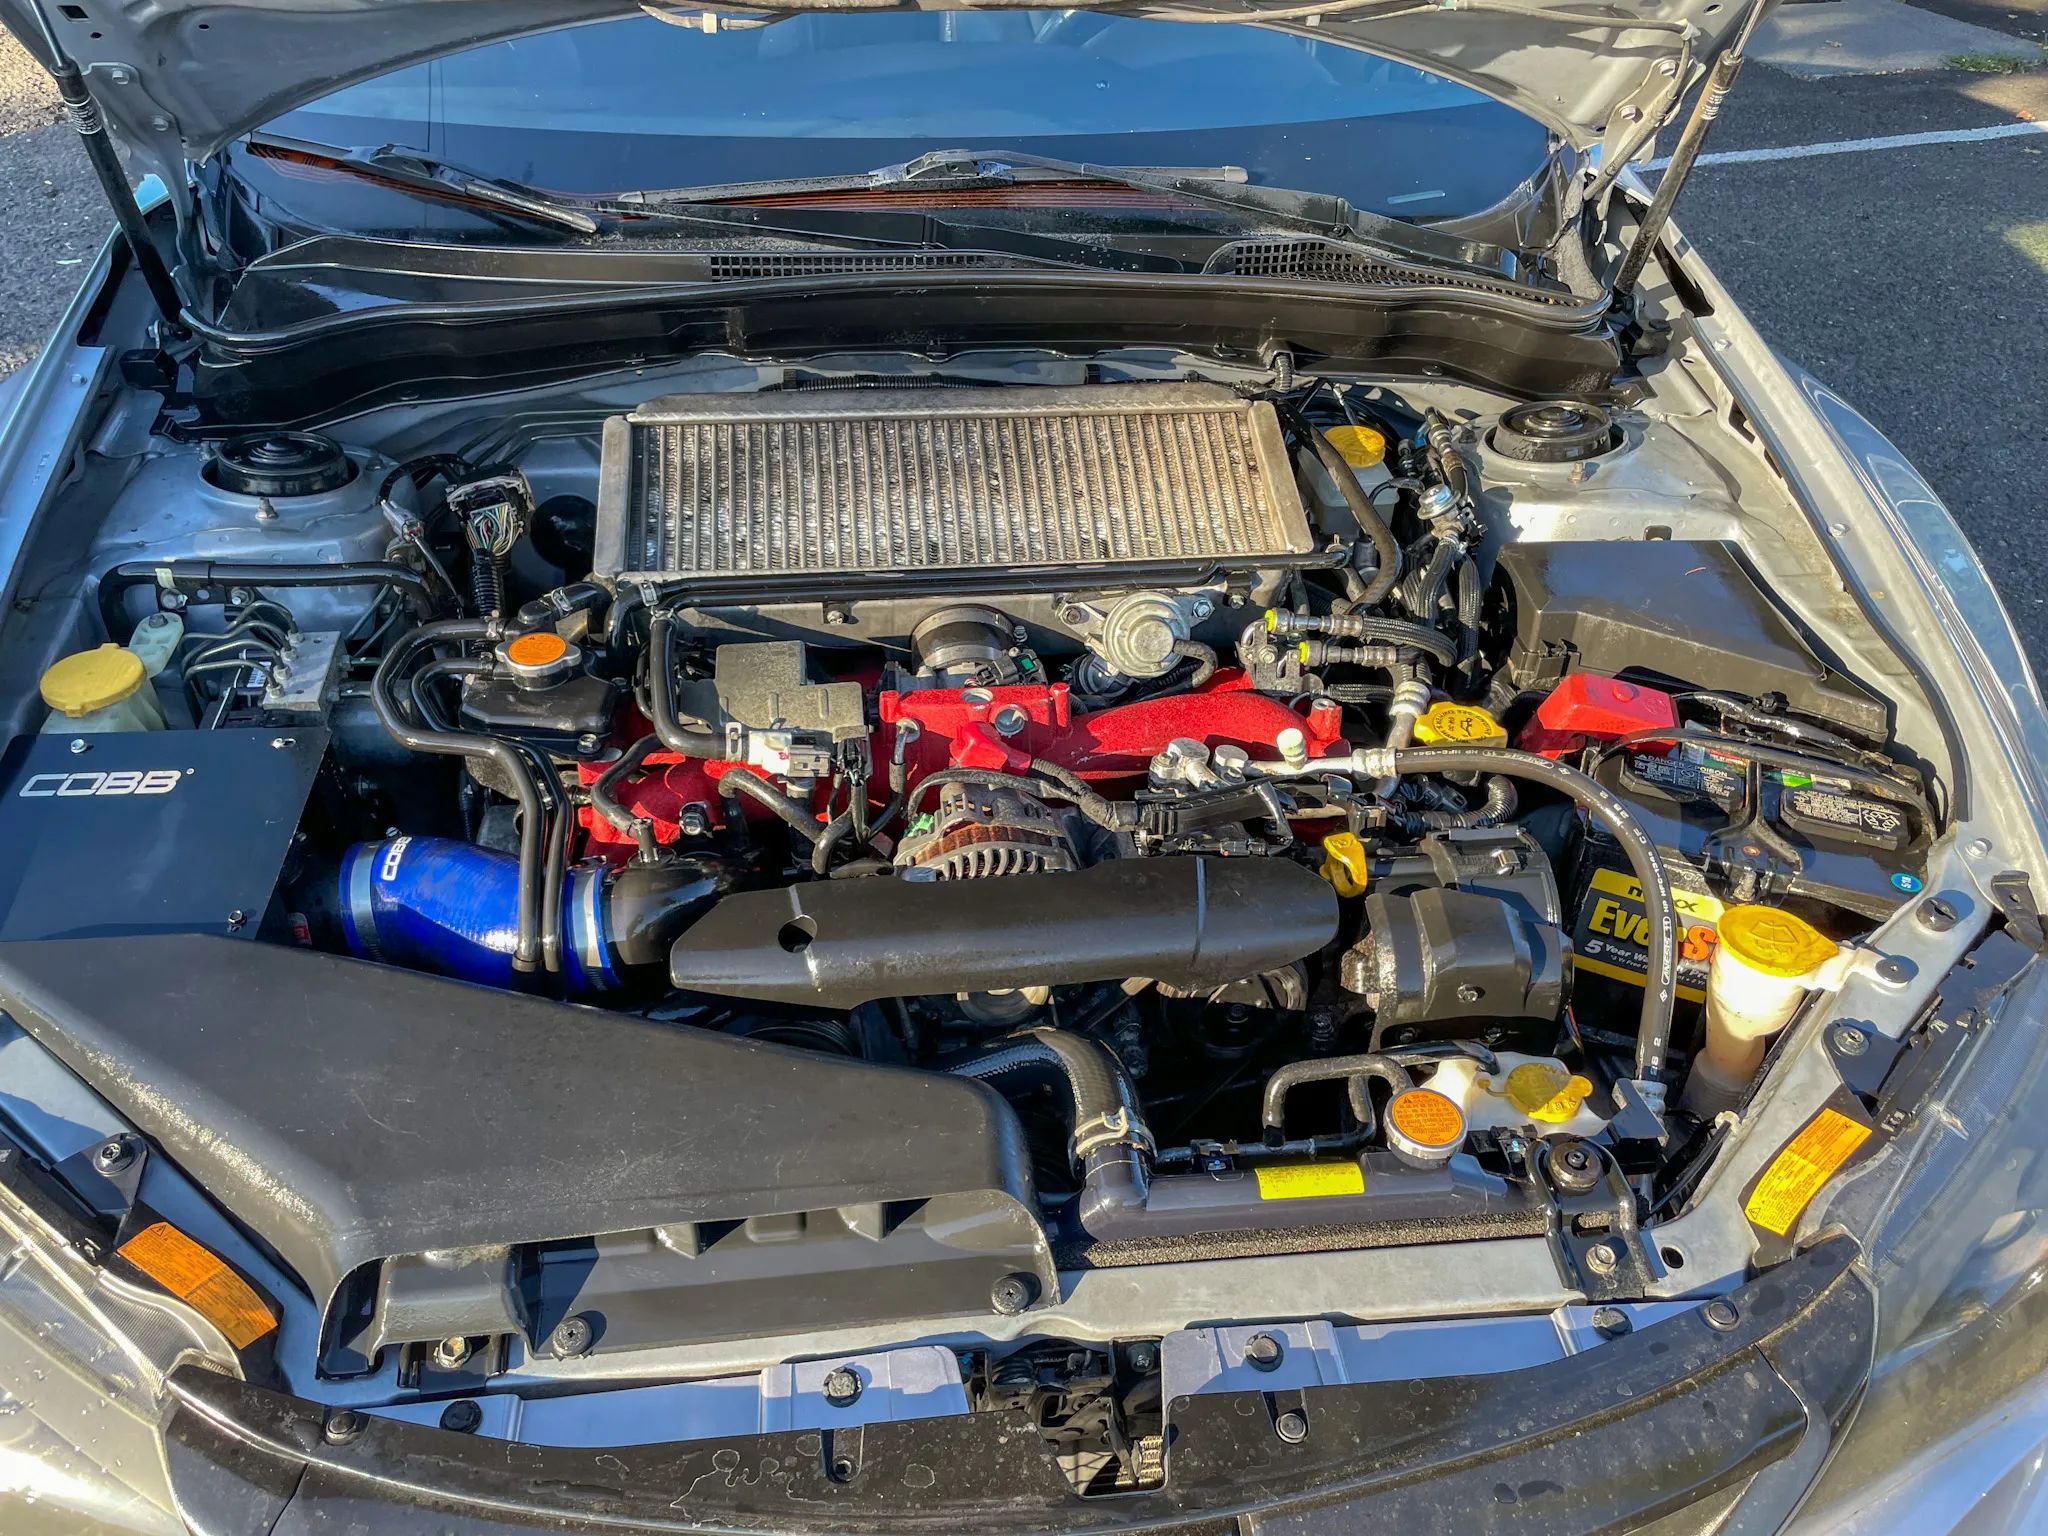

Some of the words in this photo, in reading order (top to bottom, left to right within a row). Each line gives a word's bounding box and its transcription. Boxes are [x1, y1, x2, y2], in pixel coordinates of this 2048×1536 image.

[19, 771, 182, 797] COBB
[382, 837, 412, 881] COBB
[1584, 939, 1602, 954] 5
[1605, 943, 1631, 957] Year
[1653, 1037, 1662, 1047] 2
